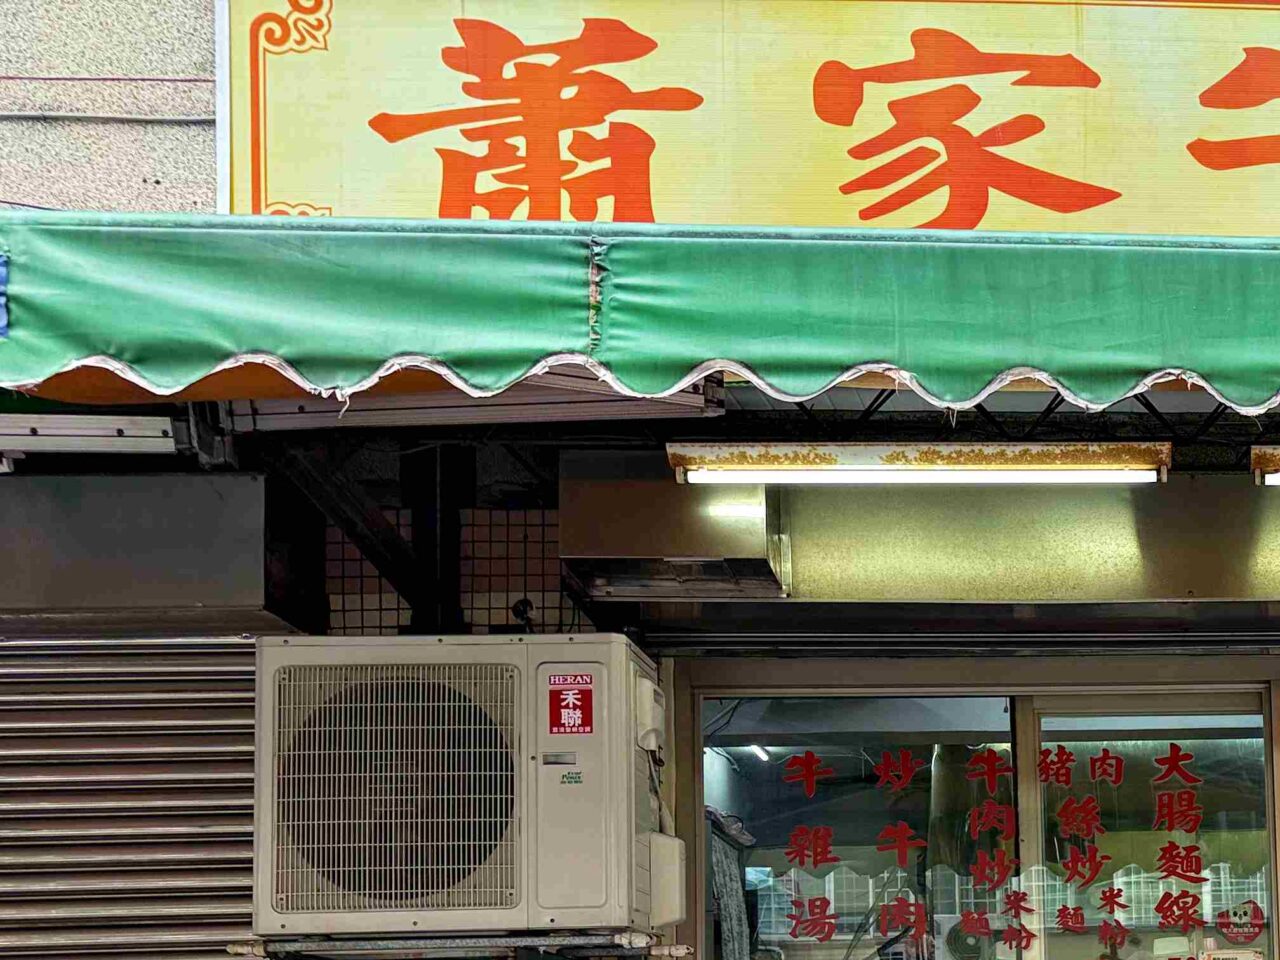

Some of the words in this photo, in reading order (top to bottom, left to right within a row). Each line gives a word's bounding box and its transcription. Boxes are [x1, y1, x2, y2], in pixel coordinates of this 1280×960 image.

[550, 675, 591, 684] HERAN
[560, 690, 582, 727] 禾聯
[1037, 745, 1125, 787] 豬肉
[783, 751, 841, 943] 牛雜湯
[873, 749, 928, 941] 炒牛肉
[965, 749, 1021, 892] 牛肉炒
[1152, 743, 1210, 935] 大腸麵線
[1056, 905, 1089, 934] 麵
[1096, 887, 1131, 949] 米粉
